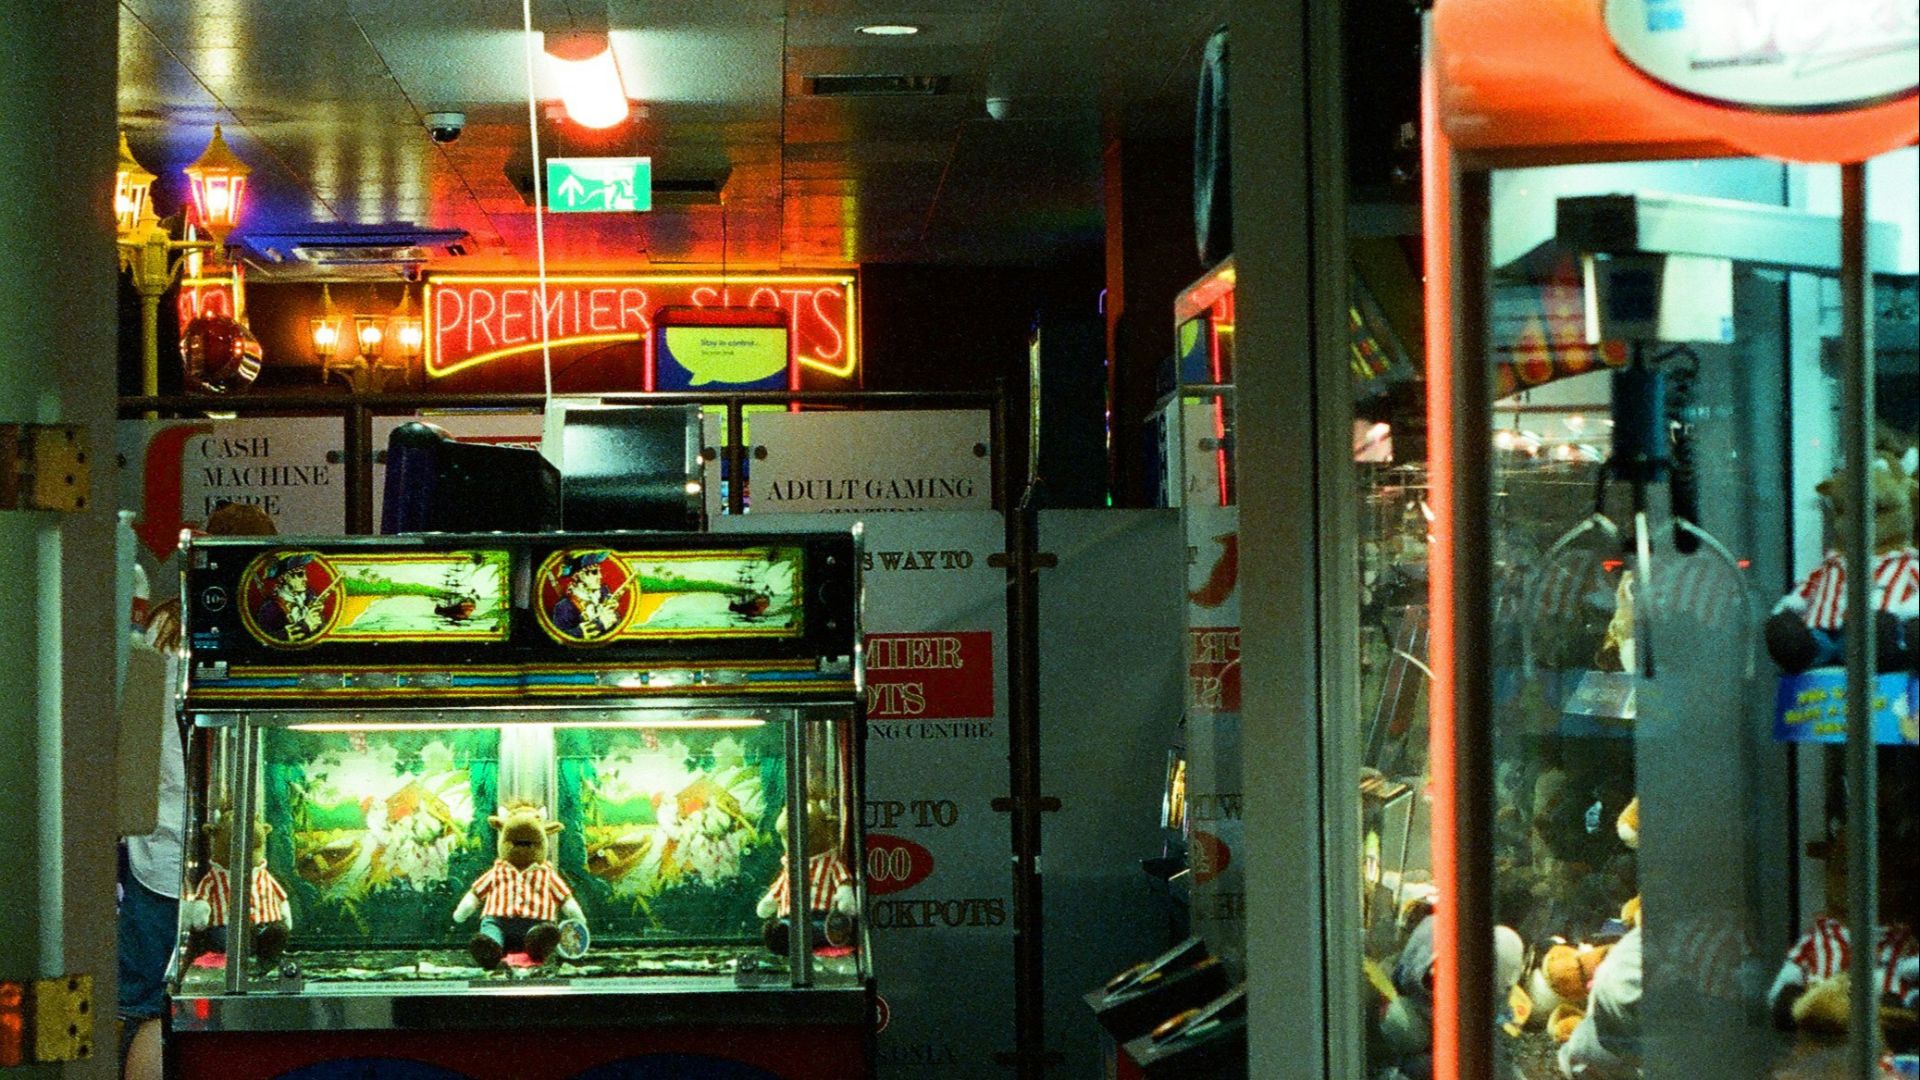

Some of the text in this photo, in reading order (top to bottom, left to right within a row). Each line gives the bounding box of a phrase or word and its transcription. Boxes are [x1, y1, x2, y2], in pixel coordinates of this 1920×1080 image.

[435, 287, 650, 363] PREMIER
[201, 437, 269, 457] CASH
[203, 466, 329, 486] MACHINE
[767, 477, 974, 501] ADULT GAMING
[877, 551, 937, 571] WAY
[940, 550, 974, 569] TO
[906, 722, 993, 739] CENTRE
[865, 799, 959, 828] UP TO
